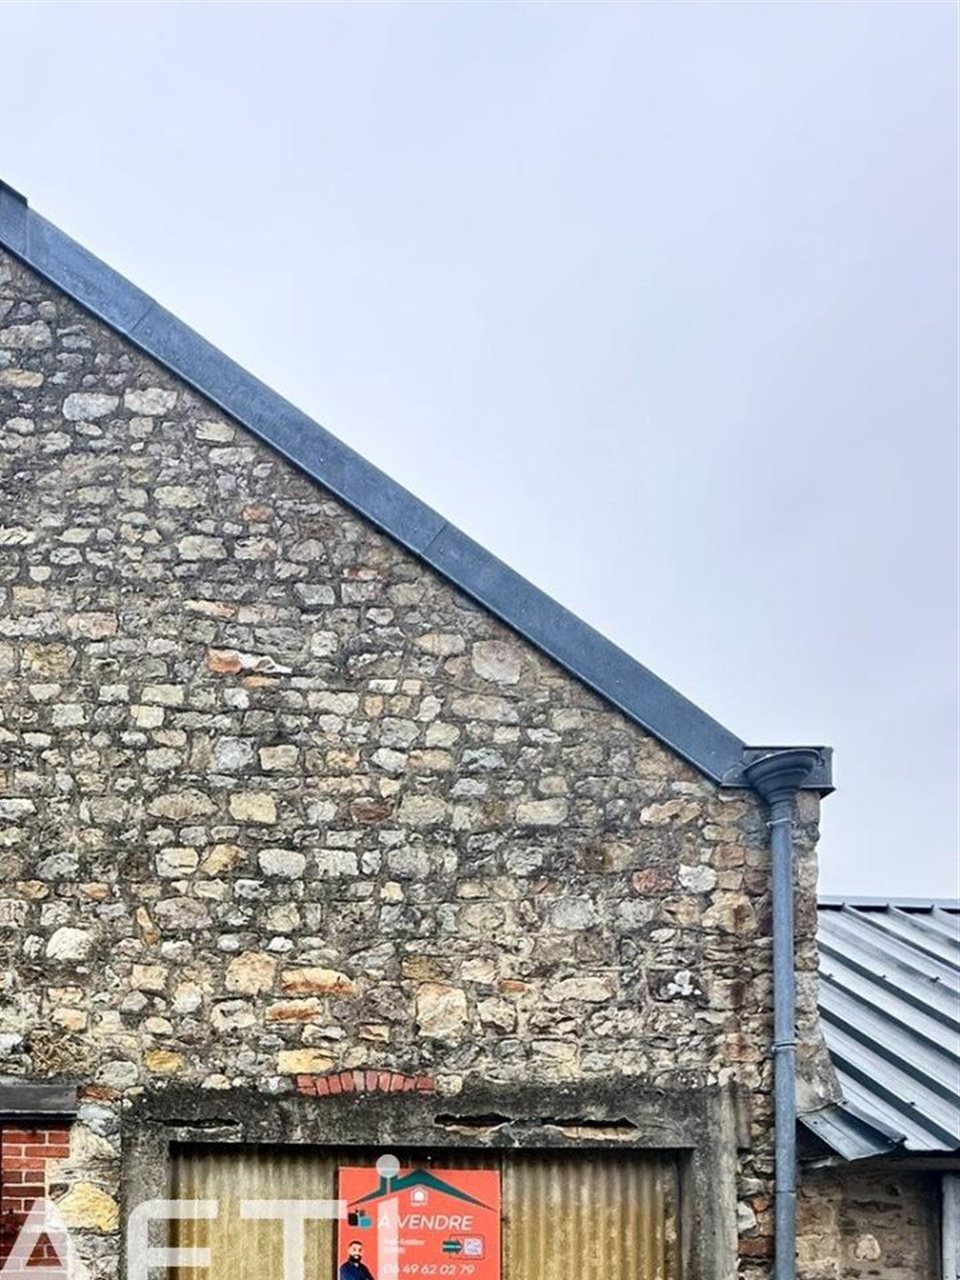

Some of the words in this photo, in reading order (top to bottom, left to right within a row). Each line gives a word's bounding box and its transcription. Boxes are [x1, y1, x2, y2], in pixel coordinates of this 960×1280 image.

[395, 1214, 474, 1231] VENDRE
[402, 1264, 419, 1275] 49
[421, 1264, 438, 1275] 62
[440, 1264, 457, 1275] 02
[460, 1264, 475, 1275] 79
